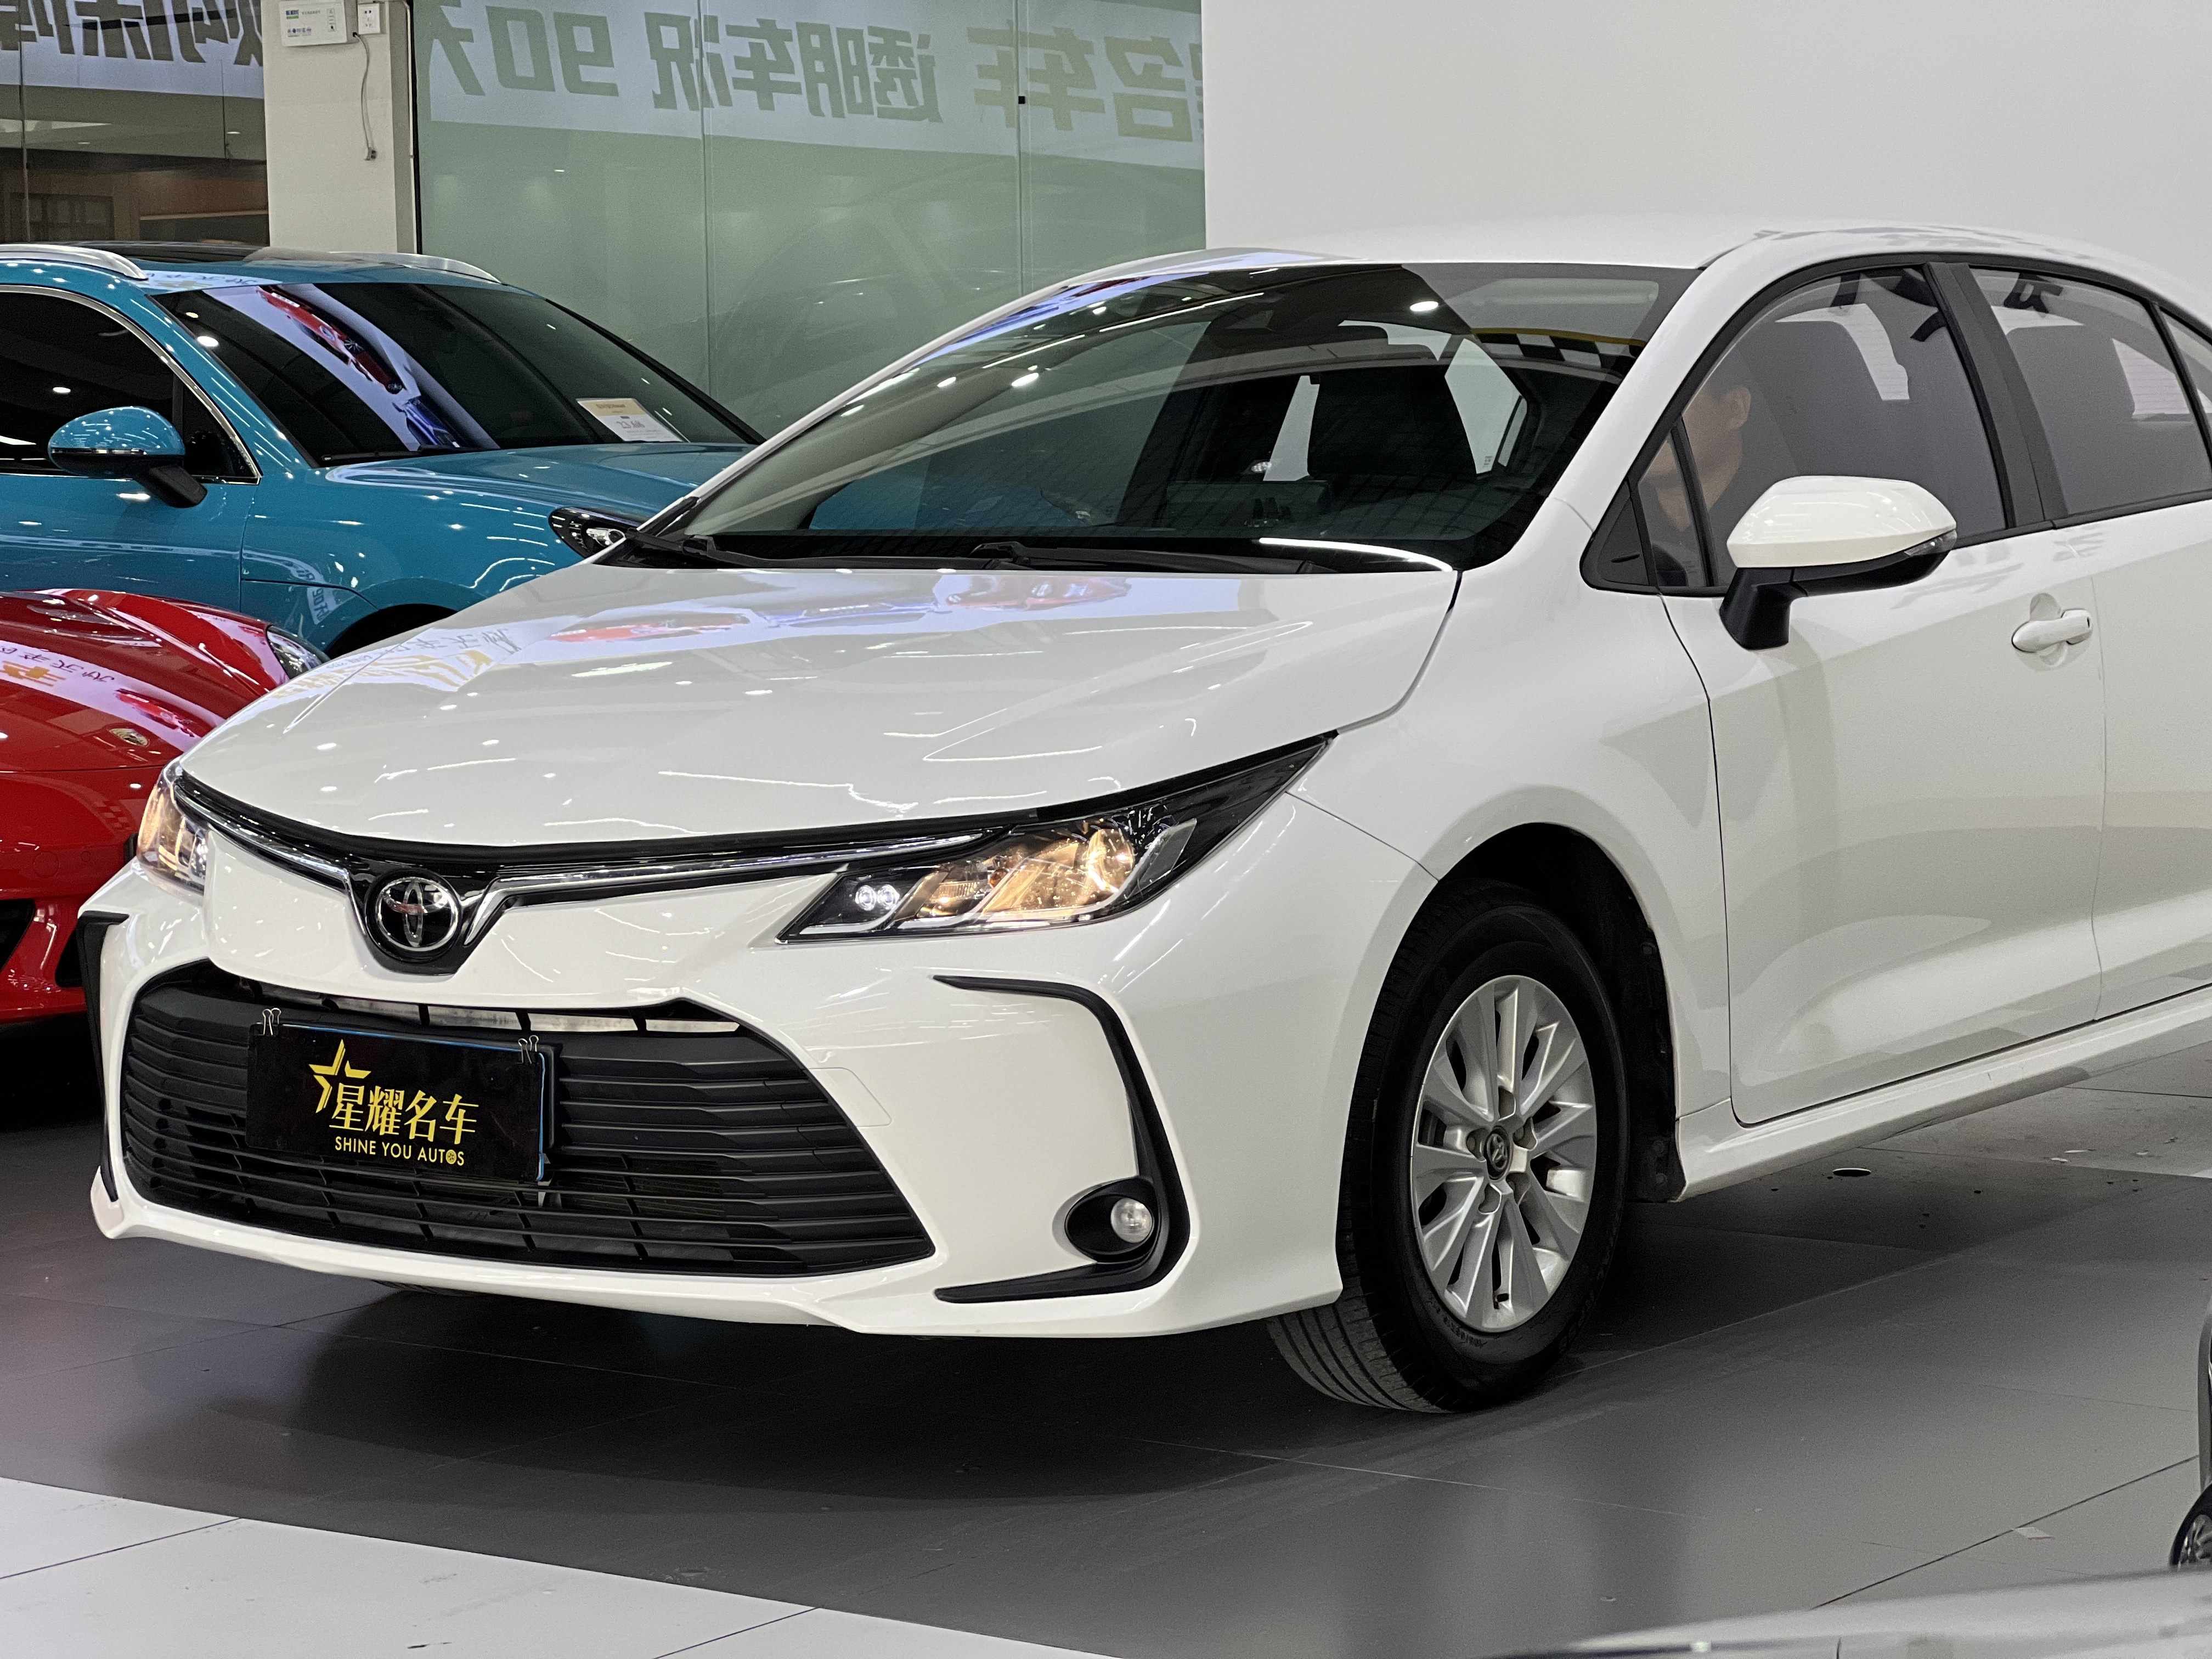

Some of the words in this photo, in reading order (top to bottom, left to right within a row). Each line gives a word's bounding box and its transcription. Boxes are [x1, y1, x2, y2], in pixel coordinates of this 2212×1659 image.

[329, 1082, 479, 1145] 星耀名车
[335, 1136, 376, 1155] SHINE
[382, 1142, 411, 1160] YOU
[417, 1147, 465, 1166] AUTOS
